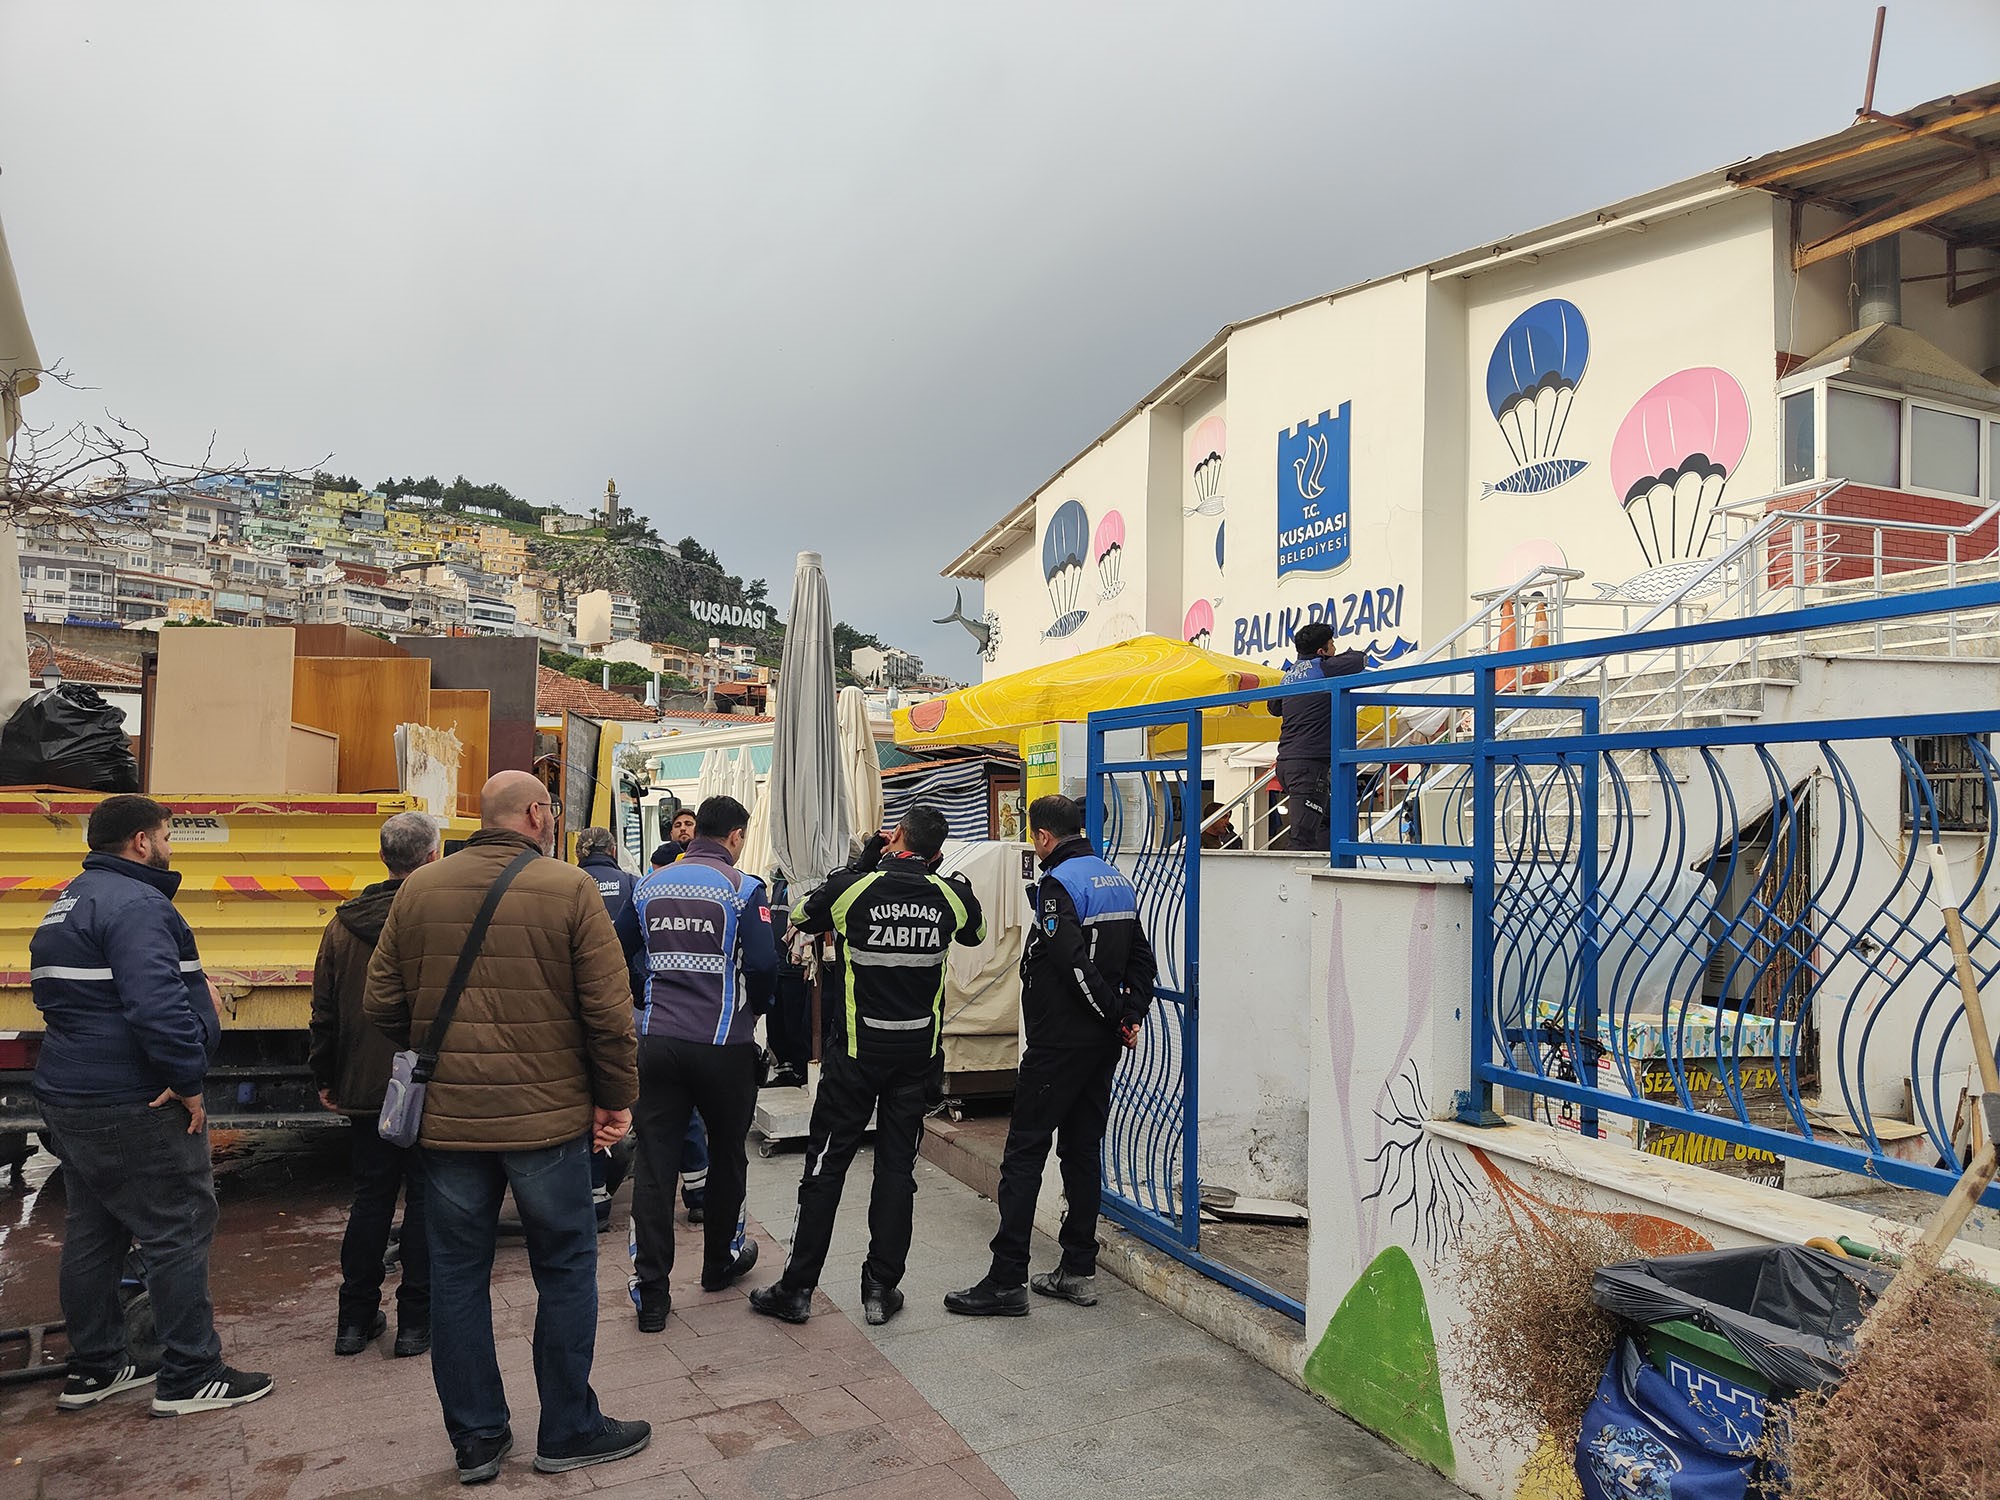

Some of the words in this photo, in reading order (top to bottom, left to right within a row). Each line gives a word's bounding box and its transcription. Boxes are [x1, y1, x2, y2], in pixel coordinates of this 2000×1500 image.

[1303, 503, 1320, 519] T.C.
[1280, 512, 1347, 548] KUŞADASI
[1280, 533, 1347, 566] BELEDİYESİ
[689, 599, 767, 630] KUŞADASI
[1233, 606, 1302, 656] BALIK
[1307, 583, 1404, 640] PAZARI
[167, 817, 219, 828] PPER
[869, 903, 943, 924] KUŞADASI
[649, 917, 715, 934] ZABITA
[867, 925, 941, 948] ZABITA
